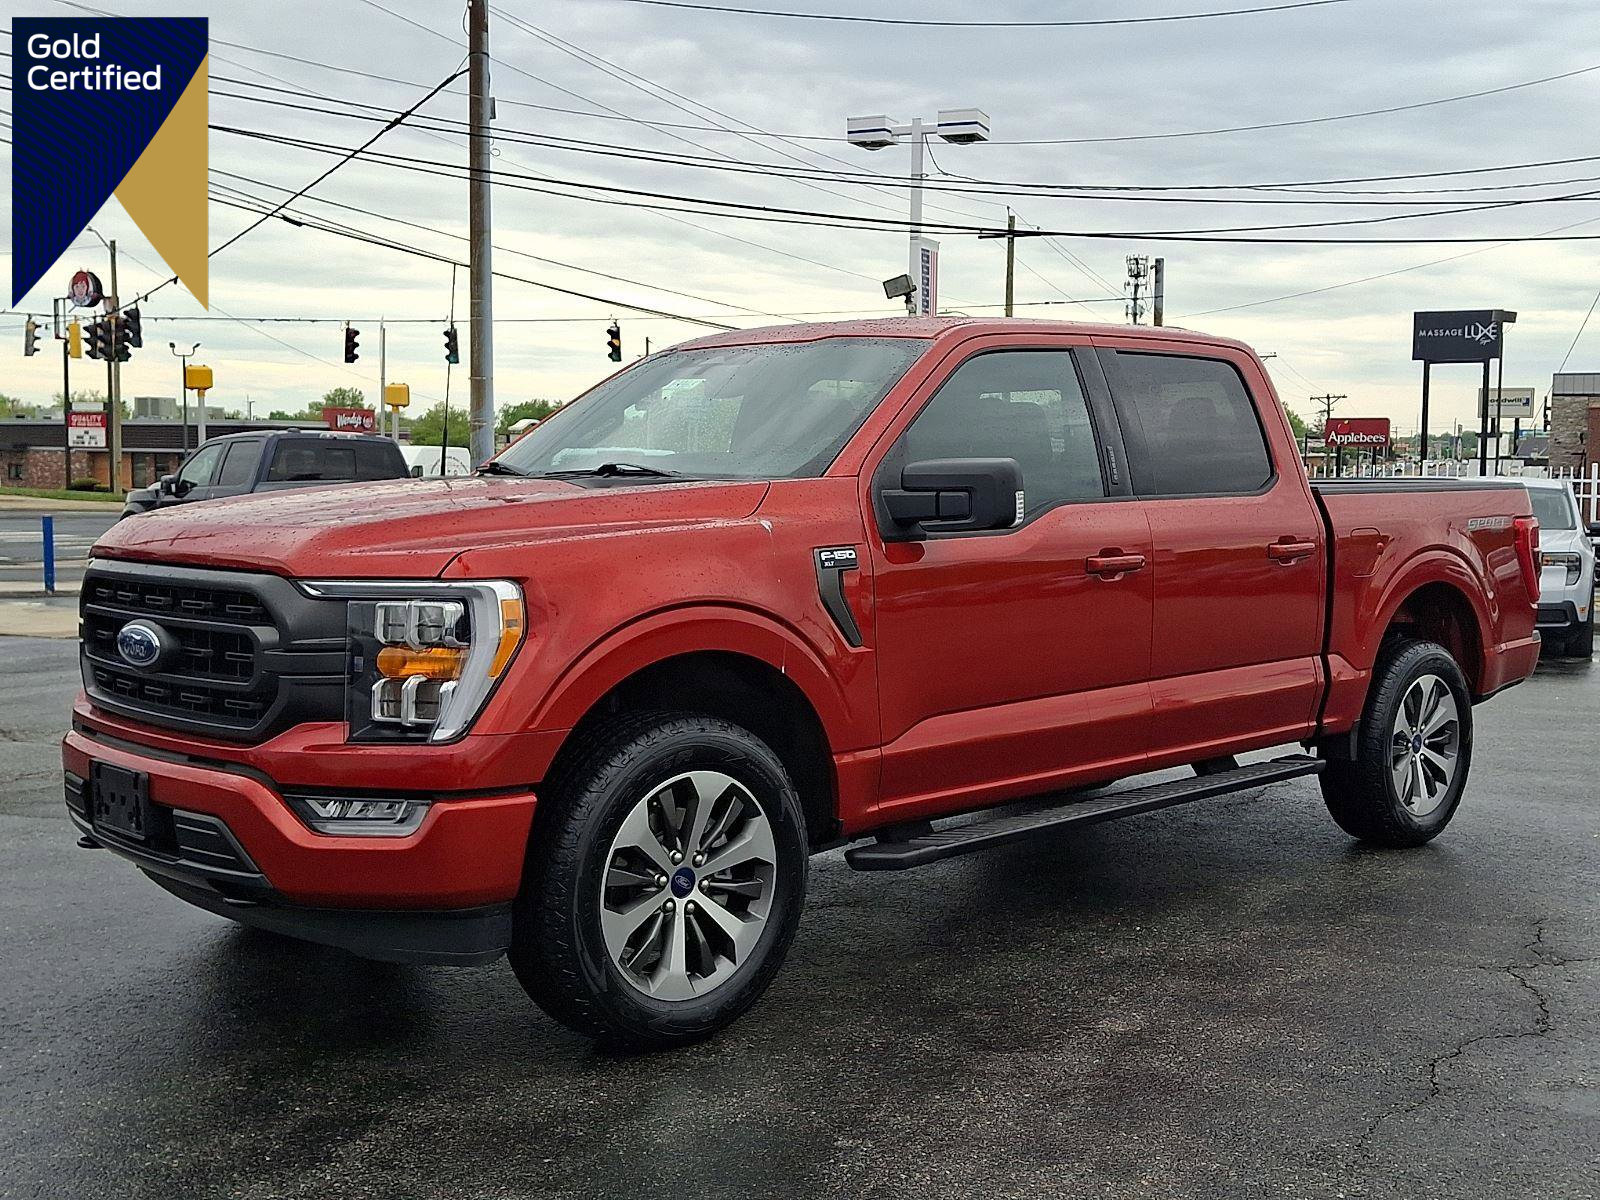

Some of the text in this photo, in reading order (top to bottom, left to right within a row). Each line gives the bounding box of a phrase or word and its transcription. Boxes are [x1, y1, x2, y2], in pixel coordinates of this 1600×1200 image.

[1418, 321, 1498, 341] MASSAGE LUXE
[71, 414, 102, 422] QUALITY
[337, 412, 363, 429] Wendy's
[1327, 430, 1386, 445] Applebee's
[820, 549, 857, 561] F-150
[824, 560, 835, 568] XLT
